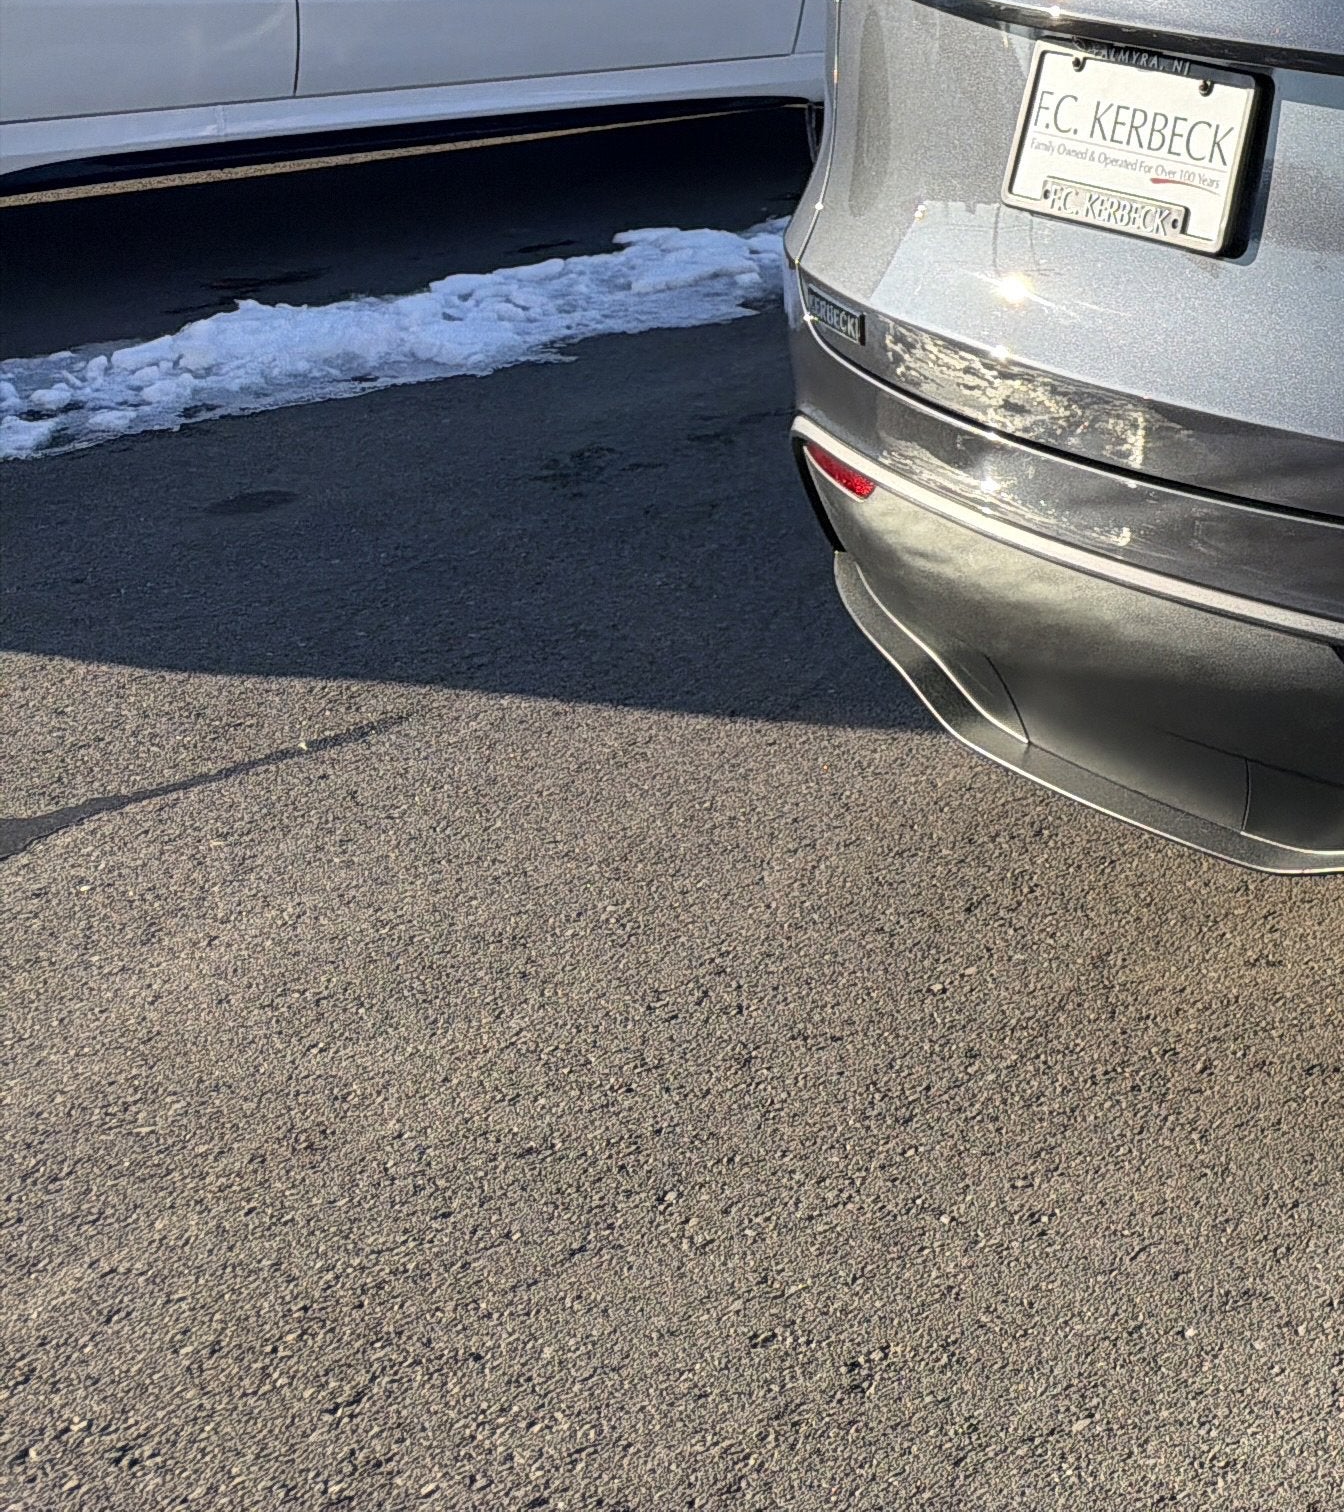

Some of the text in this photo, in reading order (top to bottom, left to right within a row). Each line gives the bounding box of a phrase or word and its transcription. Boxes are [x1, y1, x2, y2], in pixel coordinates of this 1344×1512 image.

[1033, 90, 1235, 167] F.C. KERBECK
[1155, 164, 1177, 178] Over
[1179, 170, 1195, 183] 100
[1197, 173, 1221, 190] Years
[1083, 192, 1171, 237] KERBECK
